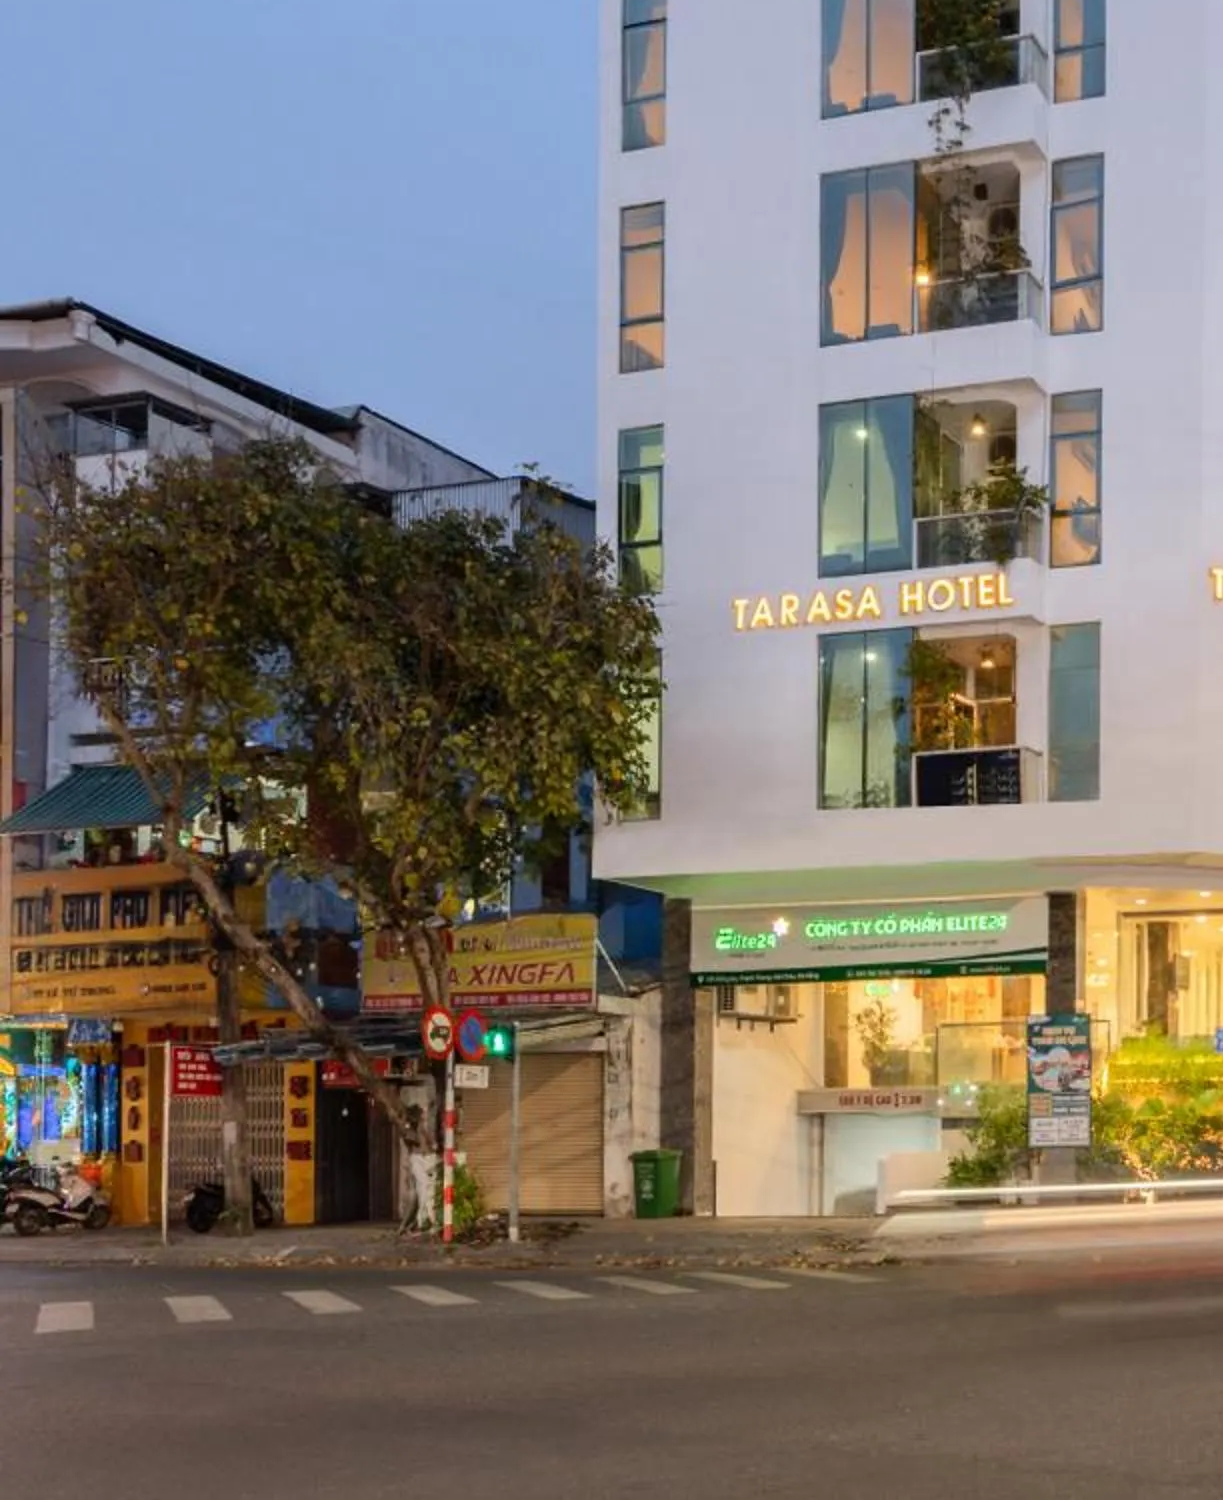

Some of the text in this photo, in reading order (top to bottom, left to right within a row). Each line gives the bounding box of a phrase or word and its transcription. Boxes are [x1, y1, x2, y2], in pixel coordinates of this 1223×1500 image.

[733, 571, 1013, 630] TARASA HOTEL
[852, 919, 873, 936] TY
[467, 962, 576, 986] XINGFA
